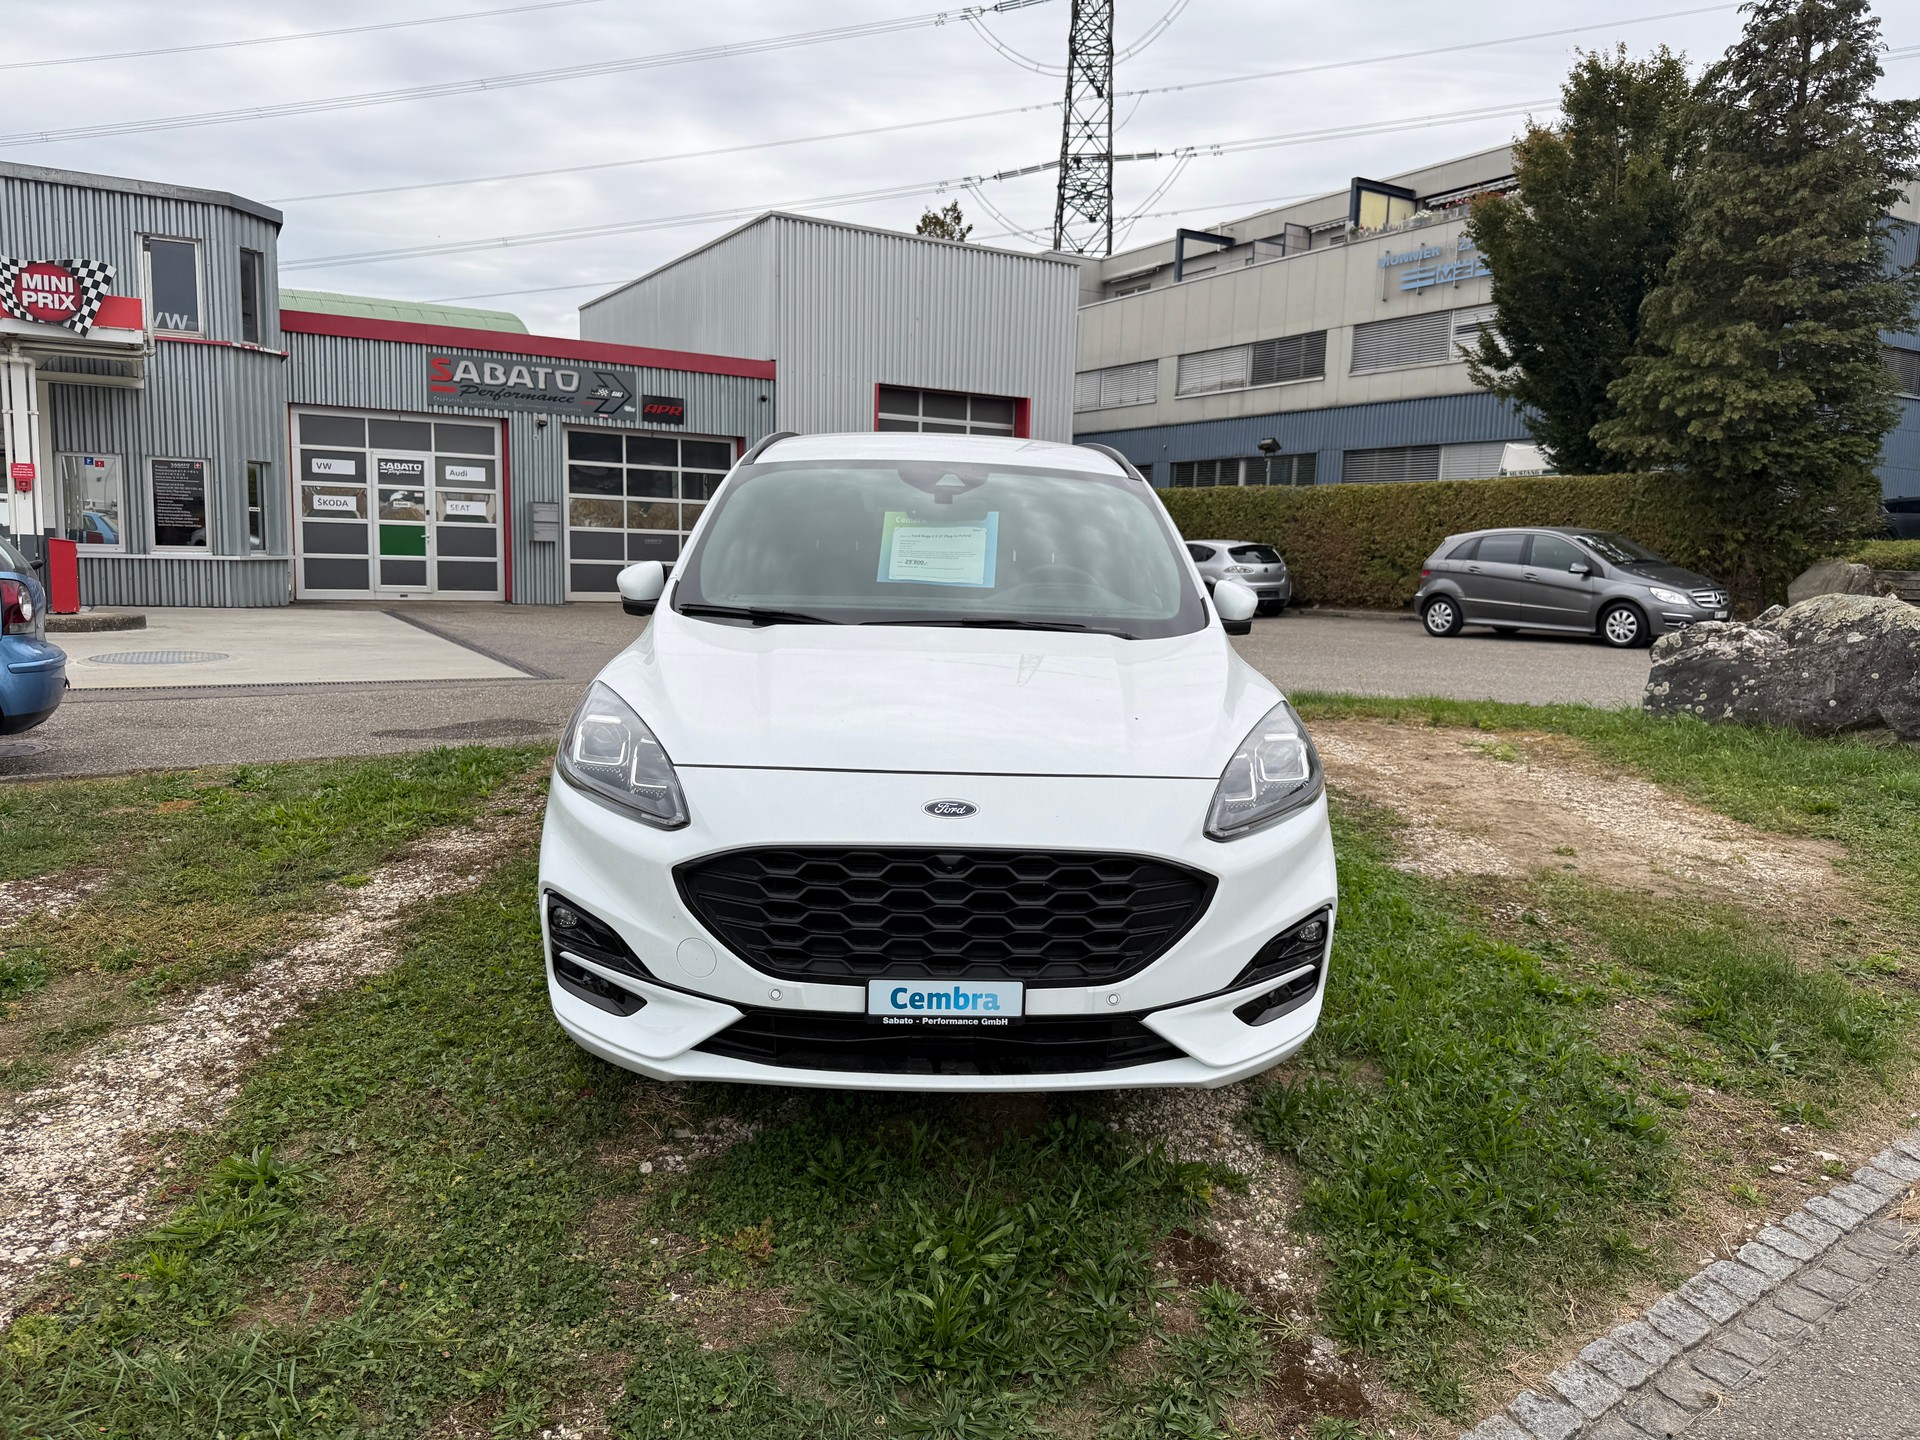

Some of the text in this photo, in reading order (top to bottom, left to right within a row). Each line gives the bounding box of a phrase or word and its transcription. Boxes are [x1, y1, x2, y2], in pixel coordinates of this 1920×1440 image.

[21, 272, 74, 293] MINI
[21, 290, 77, 312] PRIX
[430, 357, 581, 392] SABATO
[459, 384, 576, 404] Performance
[643, 403, 683, 416] APR
[316, 462, 332, 470] VW
[379, 461, 422, 471] SABATO
[449, 469, 468, 478] Audi
[317, 498, 349, 508] ŠKODA
[450, 504, 470, 512] SEAT
[934, 802, 967, 814] Ford
[890, 986, 1001, 1011] Cembra
[882, 1016, 914, 1025] Sabato
[922, 1017, 979, 1026] Performance
[981, 1017, 1009, 1026] GmbH
